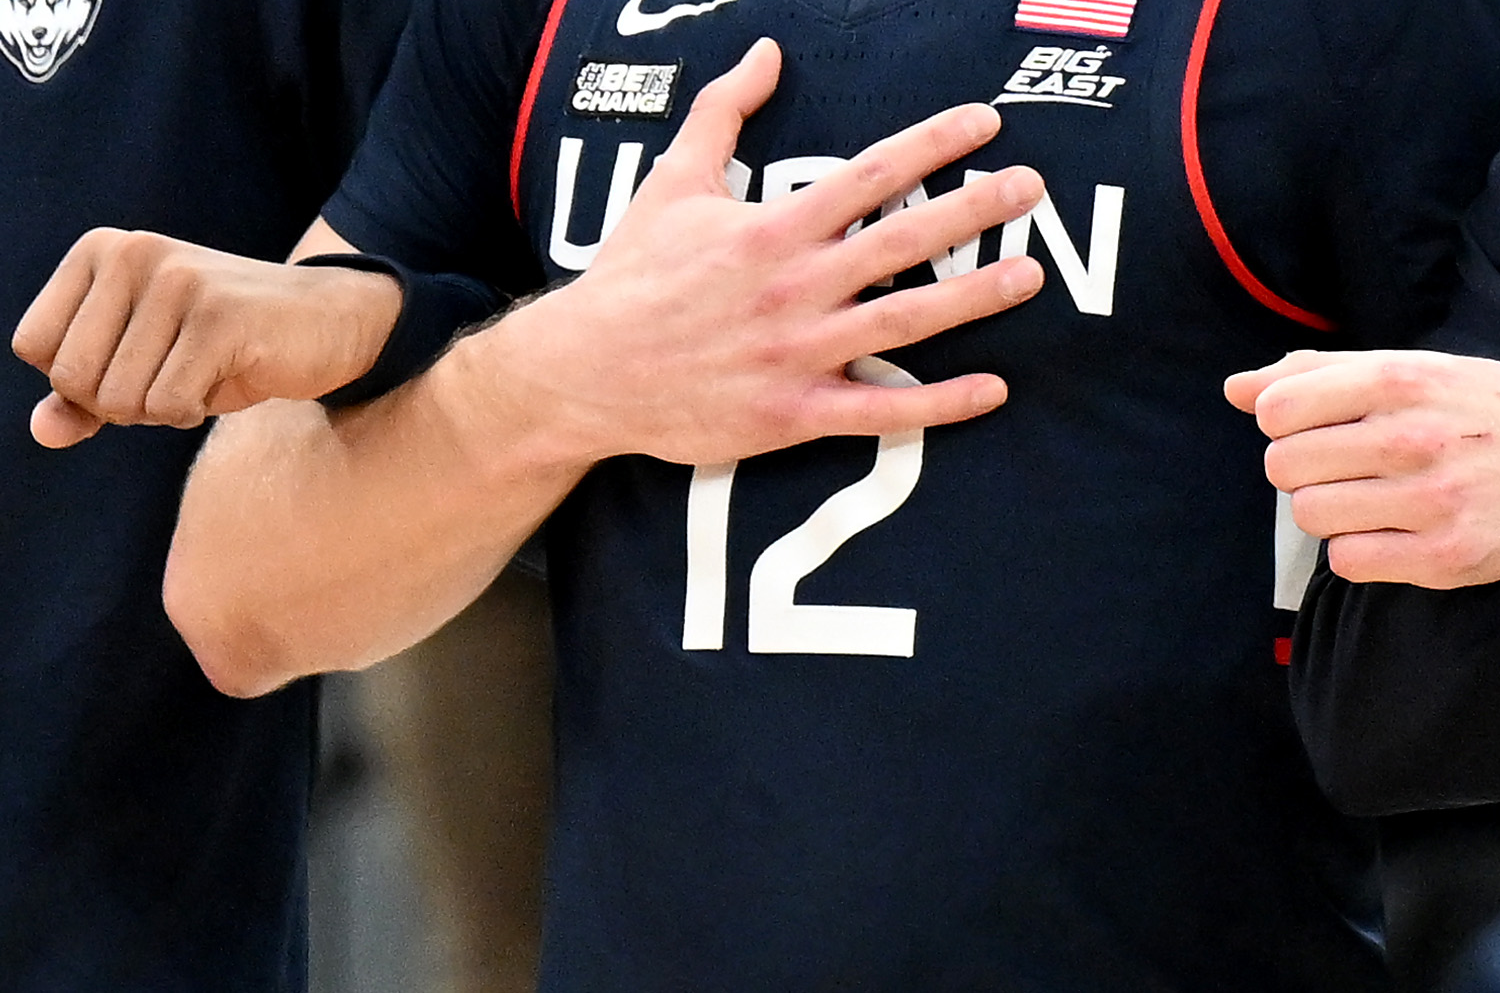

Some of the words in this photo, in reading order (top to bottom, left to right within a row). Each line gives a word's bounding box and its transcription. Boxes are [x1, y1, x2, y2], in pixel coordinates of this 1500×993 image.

[1020, 45, 1111, 74] BIG
[577, 62, 645, 92] #BE
[1003, 69, 1126, 98] EAST
[572, 89, 669, 113] CHANGE
[682, 354, 924, 658] 12
